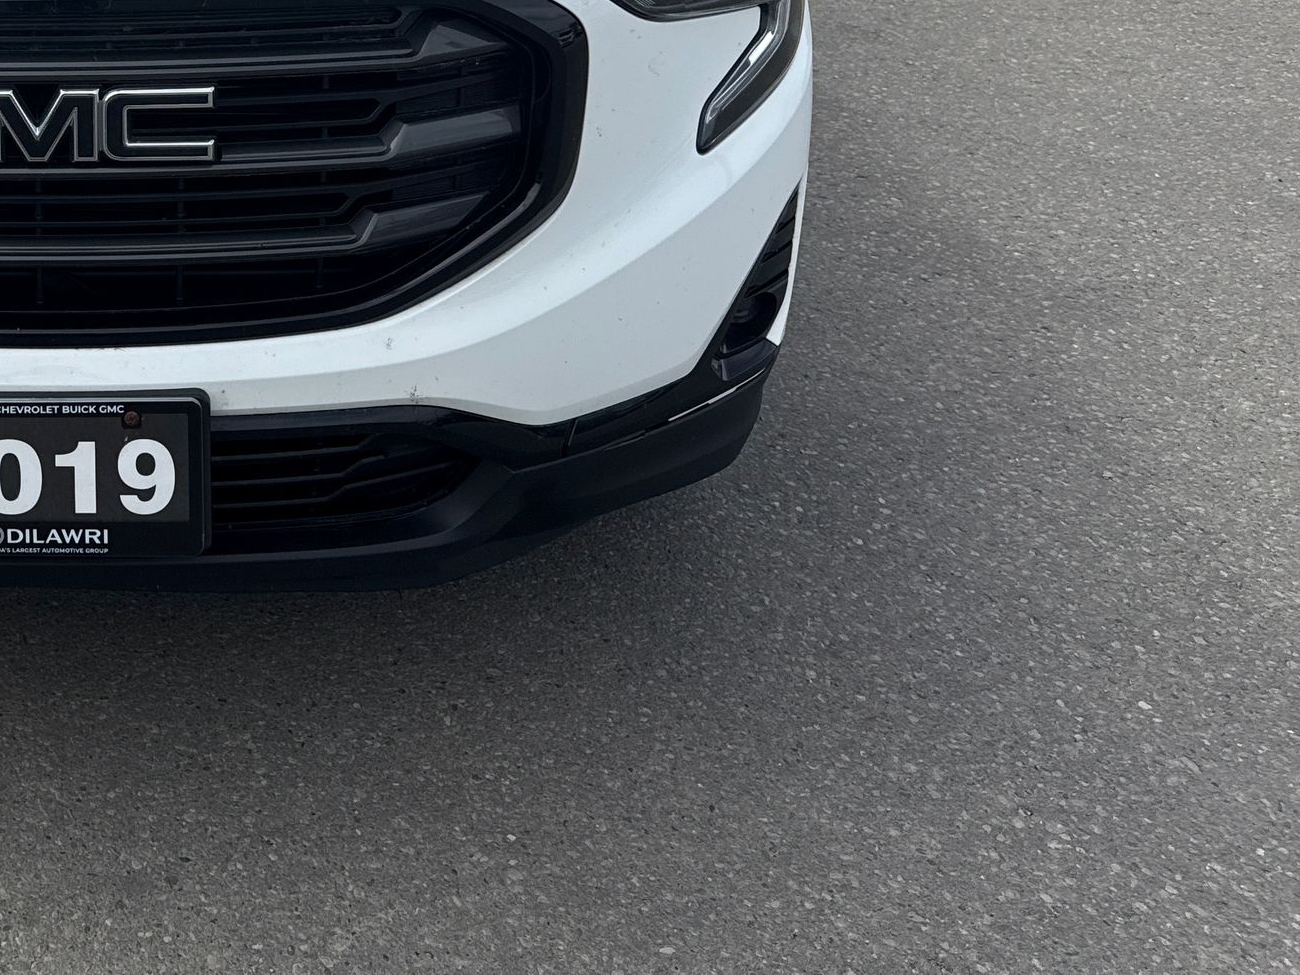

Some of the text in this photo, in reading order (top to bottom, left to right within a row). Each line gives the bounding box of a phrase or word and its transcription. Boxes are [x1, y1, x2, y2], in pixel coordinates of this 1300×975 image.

[62, 405, 96, 414] BUICK
[99, 405, 125, 414] GMC
[6, 528, 109, 544] DILAWRI
